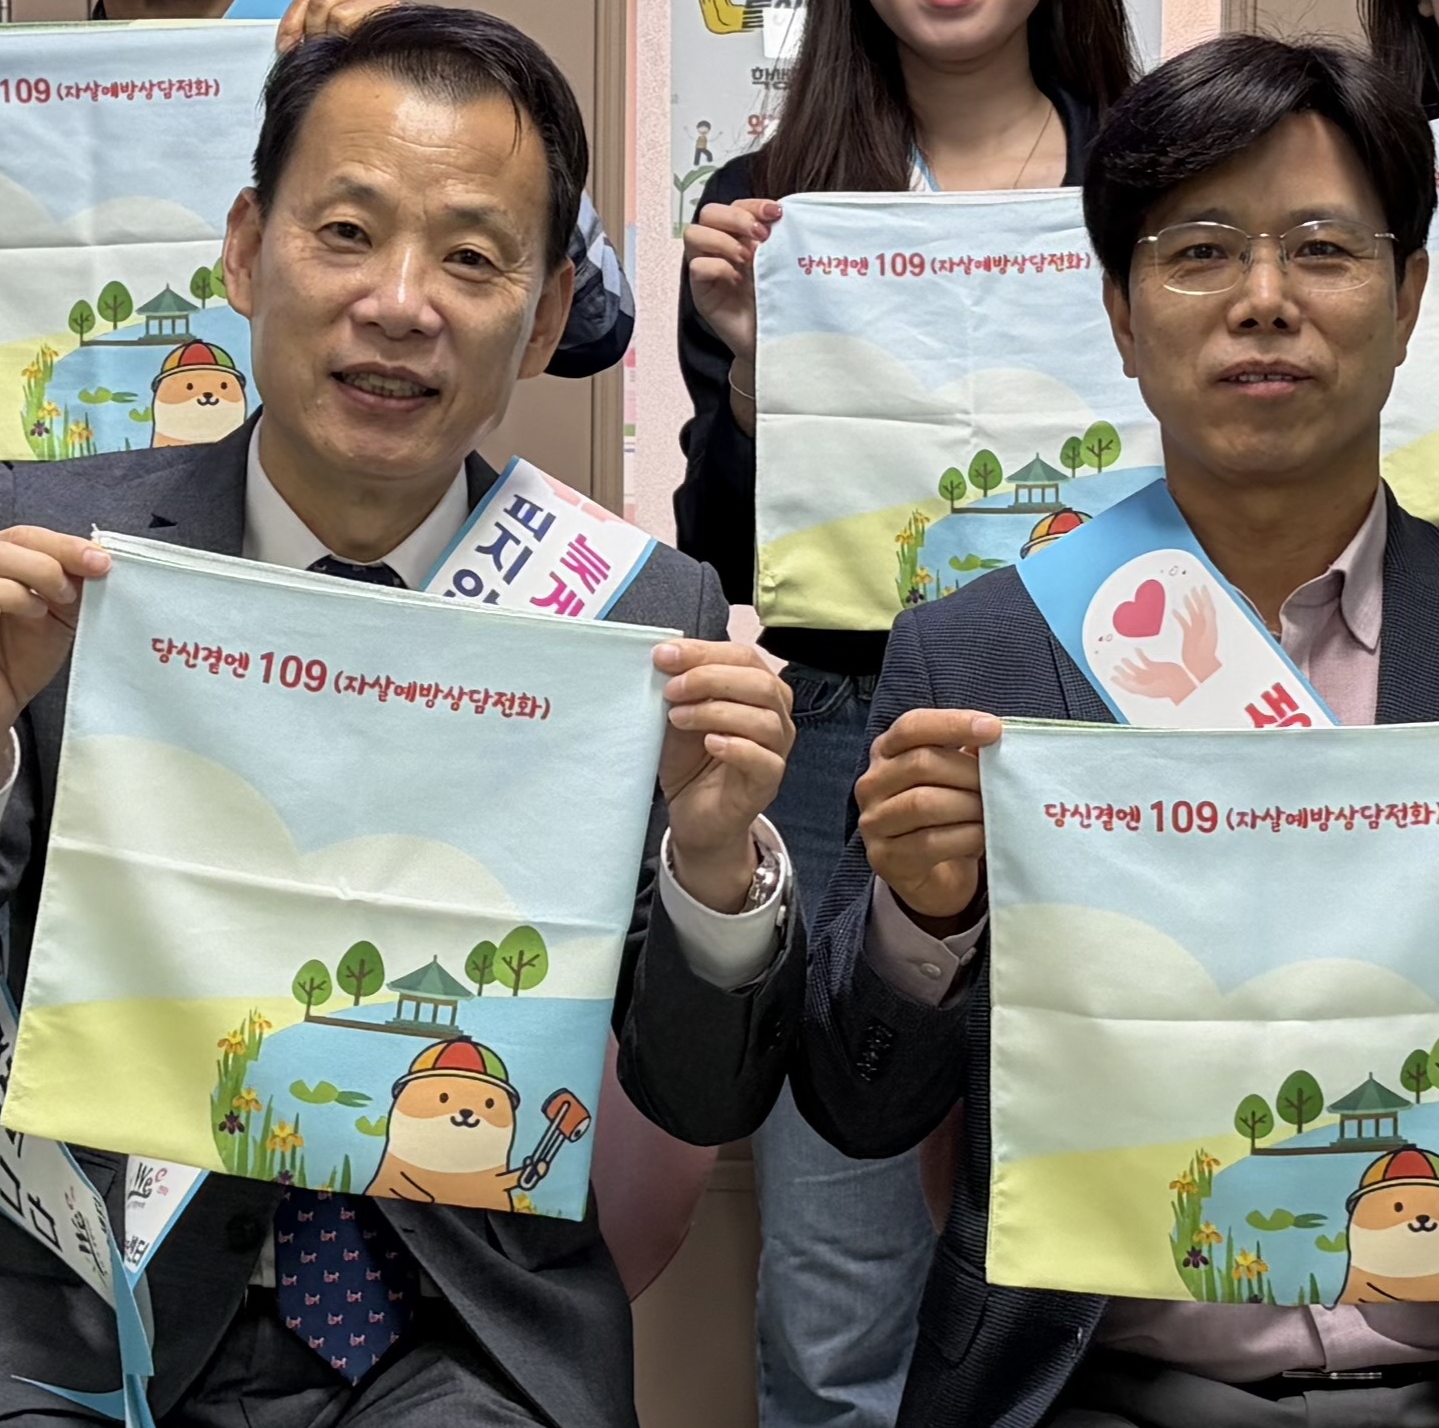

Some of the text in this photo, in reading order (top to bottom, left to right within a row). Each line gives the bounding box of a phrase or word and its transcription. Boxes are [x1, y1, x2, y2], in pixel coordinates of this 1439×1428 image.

[874, 252, 926, 278] 109
[150, 637, 552, 720] 당신곁엔 109 (자살예방상담전화)
[1043, 802, 1142, 833] 당신곁엔
[1150, 800, 1219, 835] 109
